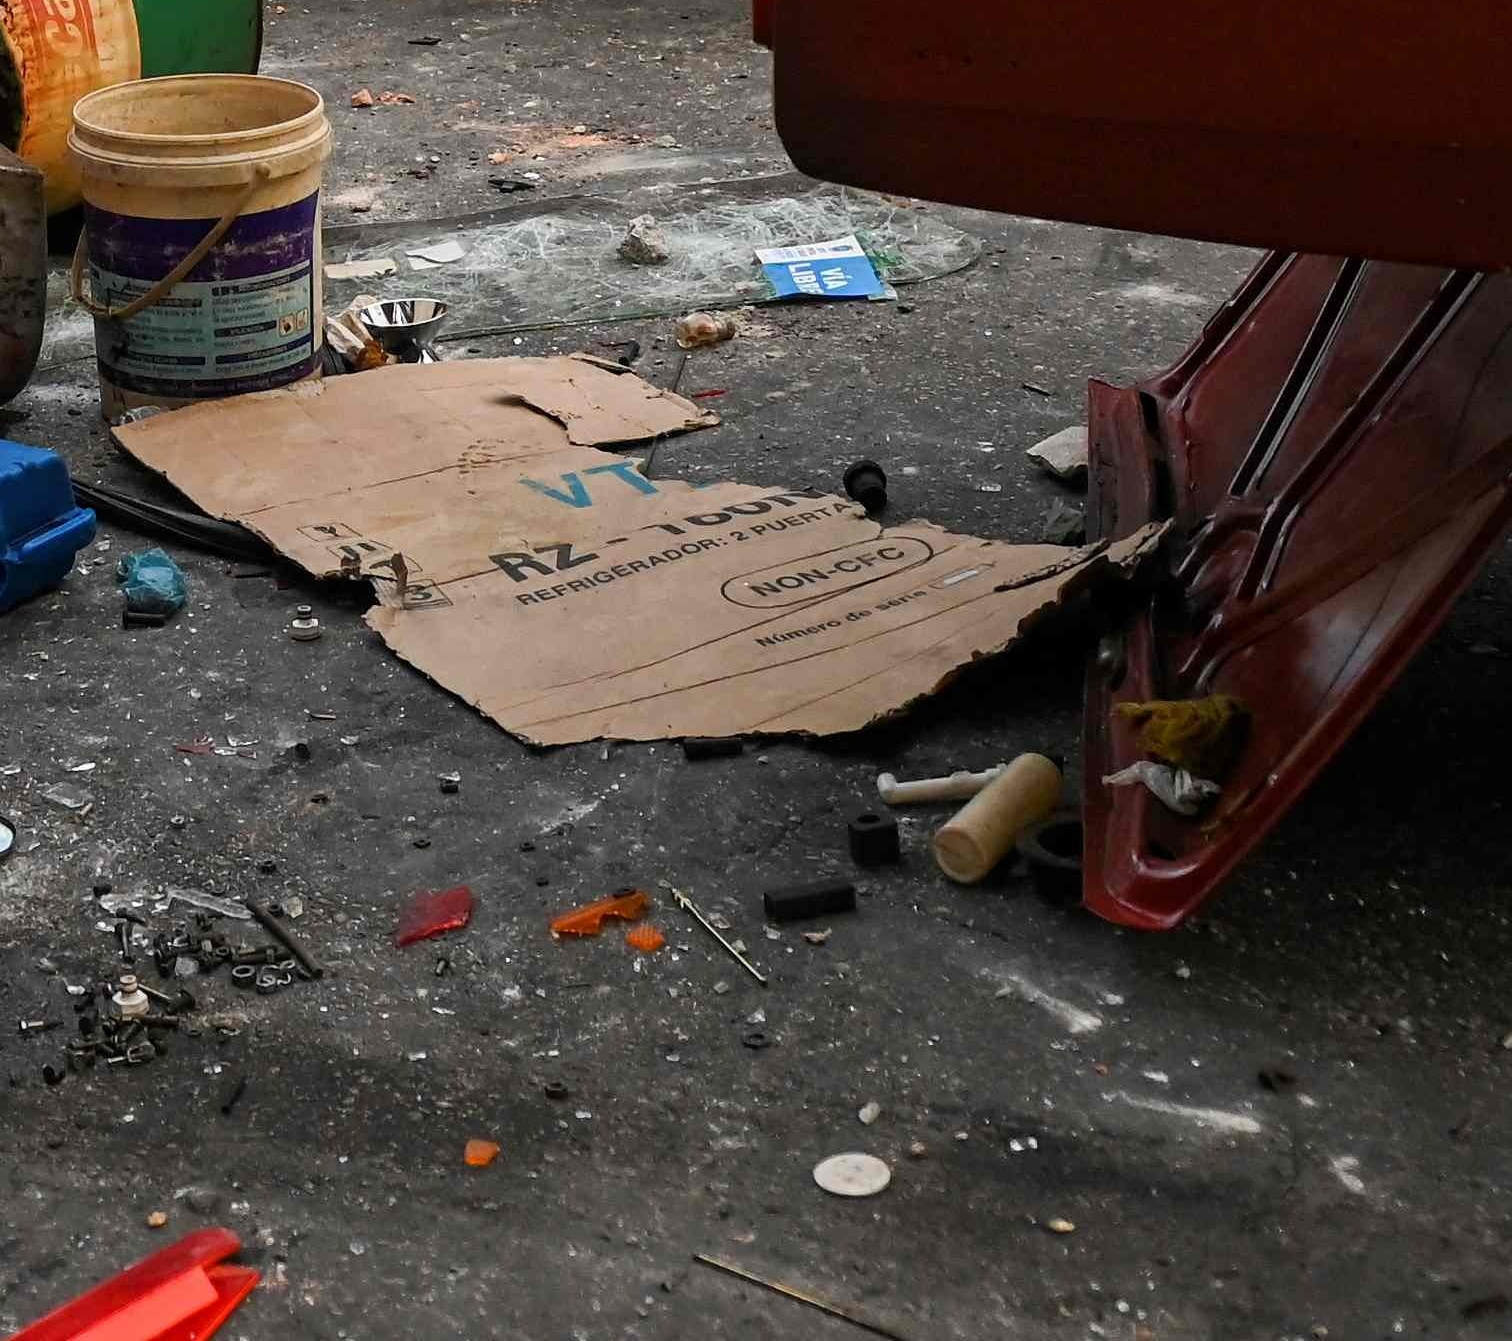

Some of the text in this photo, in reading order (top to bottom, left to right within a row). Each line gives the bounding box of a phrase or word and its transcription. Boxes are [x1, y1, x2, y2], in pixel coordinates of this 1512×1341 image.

[518, 461, 714, 508] VT
[488, 543, 600, 582] RZ
[516, 502, 852, 606] REFRIGERADOR: 2 PUERTA
[748, 547, 905, 597] NON-CFC
[755, 617, 841, 648] Número
[846, 608, 873, 622] de
